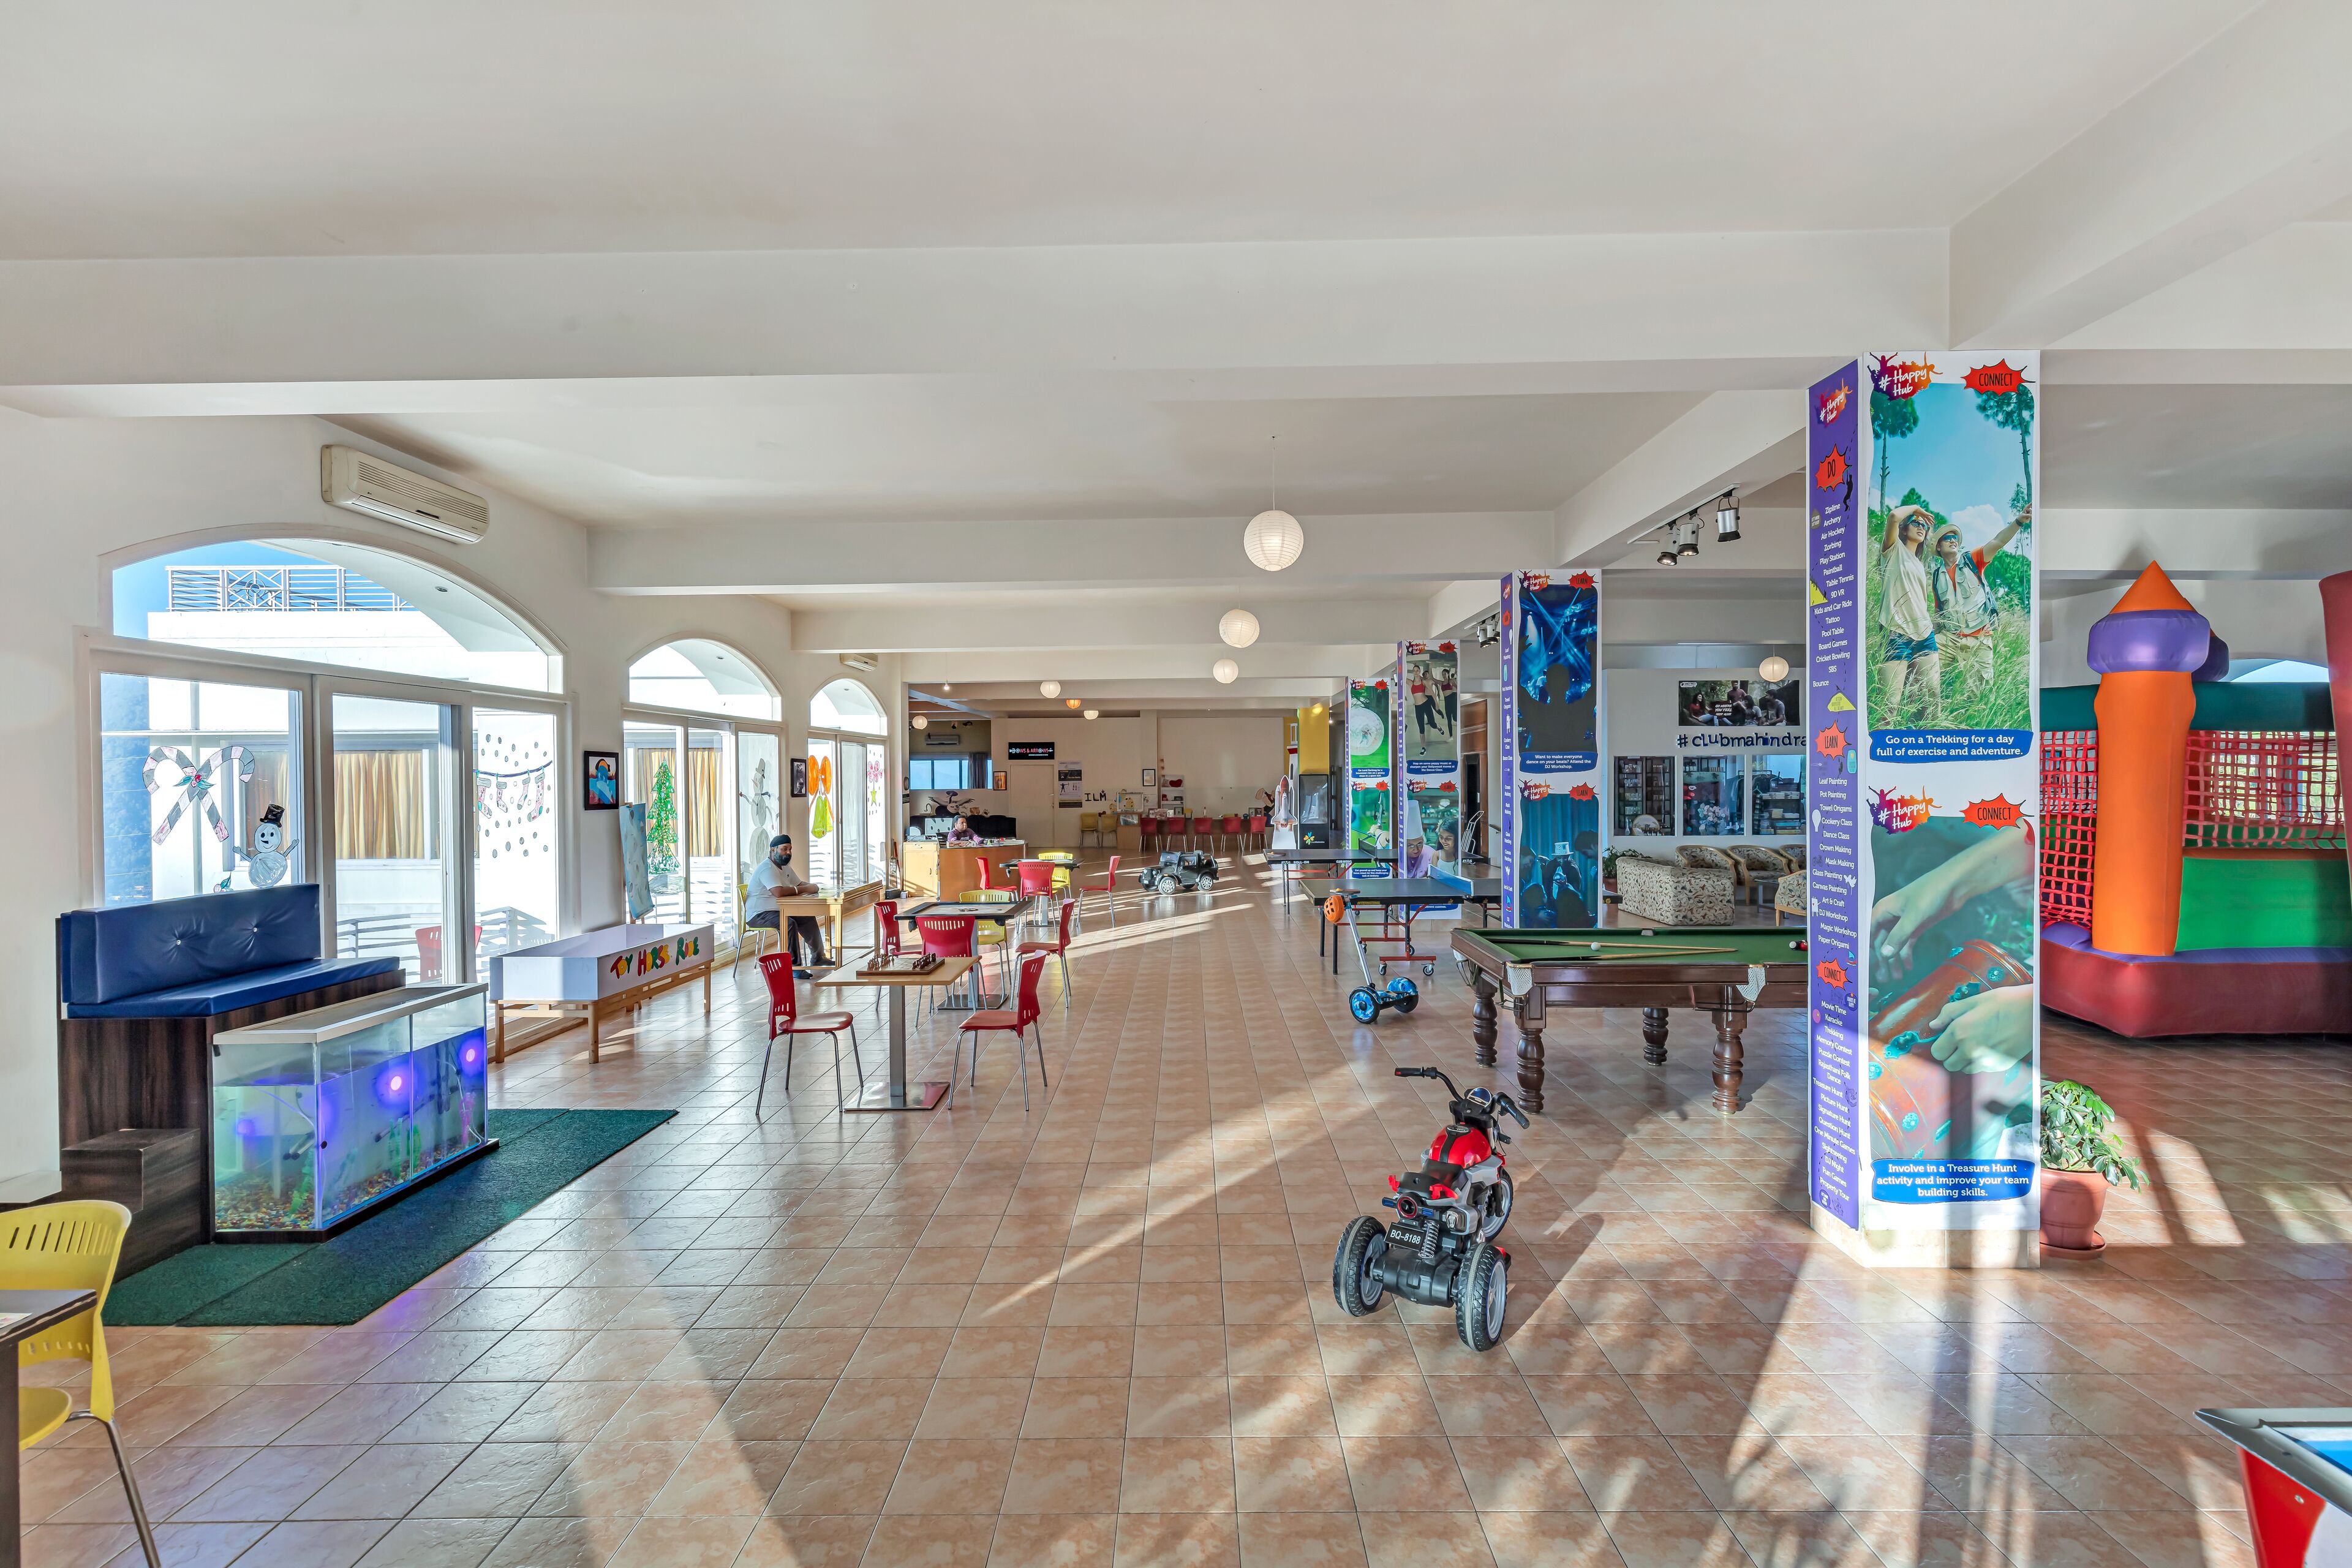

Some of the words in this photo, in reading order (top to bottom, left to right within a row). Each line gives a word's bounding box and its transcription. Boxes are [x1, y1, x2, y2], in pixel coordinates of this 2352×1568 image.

[1978, 373, 2013, 386] CONNECT
[1893, 383, 1913, 396] Hub
[1826, 410, 1837, 423] Hub
[1827, 459, 1836, 478] DO
[1825, 503, 1841, 514] Zipline
[1823, 516, 1841, 527] Archery
[1828, 527, 1845, 537] Hockey
[1824, 540, 1842, 551] Zorbing
[1830, 552, 1845, 561] Station
[1823, 564, 1842, 576] Paintball
[1826, 579, 1838, 587] Table
[1839, 574, 1854, 584] Tennis
[1832, 639, 1847, 648] Games
[1832, 651, 1850, 660] Bowling
[1825, 735, 1838, 748] LEARN
[1885, 735, 1900, 744] Go
[1926, 734, 1969, 745] Trekking
[1971, 734, 1986, 744] for
[1996, 734, 2015, 745] day
[1877, 747, 1893, 756] full
[1895, 747, 1905, 756] of
[1907, 747, 1947, 756] exercise
[1950, 747, 1969, 755] and
[1970, 747, 2023, 756] adventure.
[1828, 791, 1846, 800] Painting
[1833, 805, 1852, 813] Origami
[1977, 807, 2011, 821] CONNECT
[1821, 817, 1840, 826] Cookery
[1892, 816, 1912, 829] Hub
[1834, 845, 1852, 855] Making
[1838, 859, 1855, 869] Making
[1824, 870, 1842, 881] Painting
[1812, 882, 1828, 891] Canvas
[1828, 884, 1847, 895] Painting
[1833, 899, 1845, 907] Craft
[1825, 910, 1848, 923] Workshop
[1820, 922, 1834, 932] Magic
[1834, 925, 1857, 938] Workshop
[1818, 935, 1830, 944] Paper
[1831, 938, 1849, 949] Origami
[610, 954, 633, 979] TOY
[1824, 967, 1841, 982] CONNECT
[1821, 1000, 1834, 1011] Movie
[1835, 1005, 1847, 1016] Time
[1825, 1014, 1842, 1027] Karaoke
[1825, 1026, 1844, 1041] Trekking
[1816, 1035, 1834, 1049] Memory
[1834, 1042, 1852, 1055] Contest
[1819, 1047, 1832, 1058] Puzzle
[1833, 1054, 1850, 1067] Contest
[1818, 1059, 1841, 1074] Rajasthani
[1841, 1069, 1850, 1080] Folk
[1827, 1072, 1841, 1085] Dance
[1813, 1077, 1831, 1092] Treasure
[1831, 1086, 1843, 1098] Hunt
[1820, 1093, 1836, 1107] Picture
[1836, 1101, 1849, 1113] Hunt
[1818, 1104, 1839, 1120] Signature
[1839, 1115, 1851, 1127] Hunt
[1819, 1116, 1838, 1133] Question
[1839, 1127, 1850, 1140] Hunt
[1814, 1126, 1824, 1136] One
[1823, 1131, 1839, 1145] Minute
[1839, 1140, 1855, 1155] Games
[1822, 1142, 1847, 1164] Sightseeing
[1825, 1155, 1831, 1164] DJ
[1831, 1159, 1844, 1174] Night
[1888, 1164, 1924, 1172] Involve
[1927, 1164, 1937, 1172] in
[1947, 1164, 1990, 1172] Treasure
[1992, 1164, 2017, 1172] Hunt
[1822, 1166, 1831, 1177] Fun
[1831, 1172, 1847, 1188] Games
[1877, 1176, 1913, 1186] activity
[1915, 1176, 1934, 1185] and
[1936, 1176, 1977, 1186] improve
[1978, 1177, 2002, 1186] your
[1819, 1176, 1838, 1195] Property
[1839, 1189, 1850, 1201] Tour
[1917, 1188, 1959, 1199] building
[1961, 1188, 1988, 1196] skills.
[1390, 1229, 1421, 1244] BQ-8188
